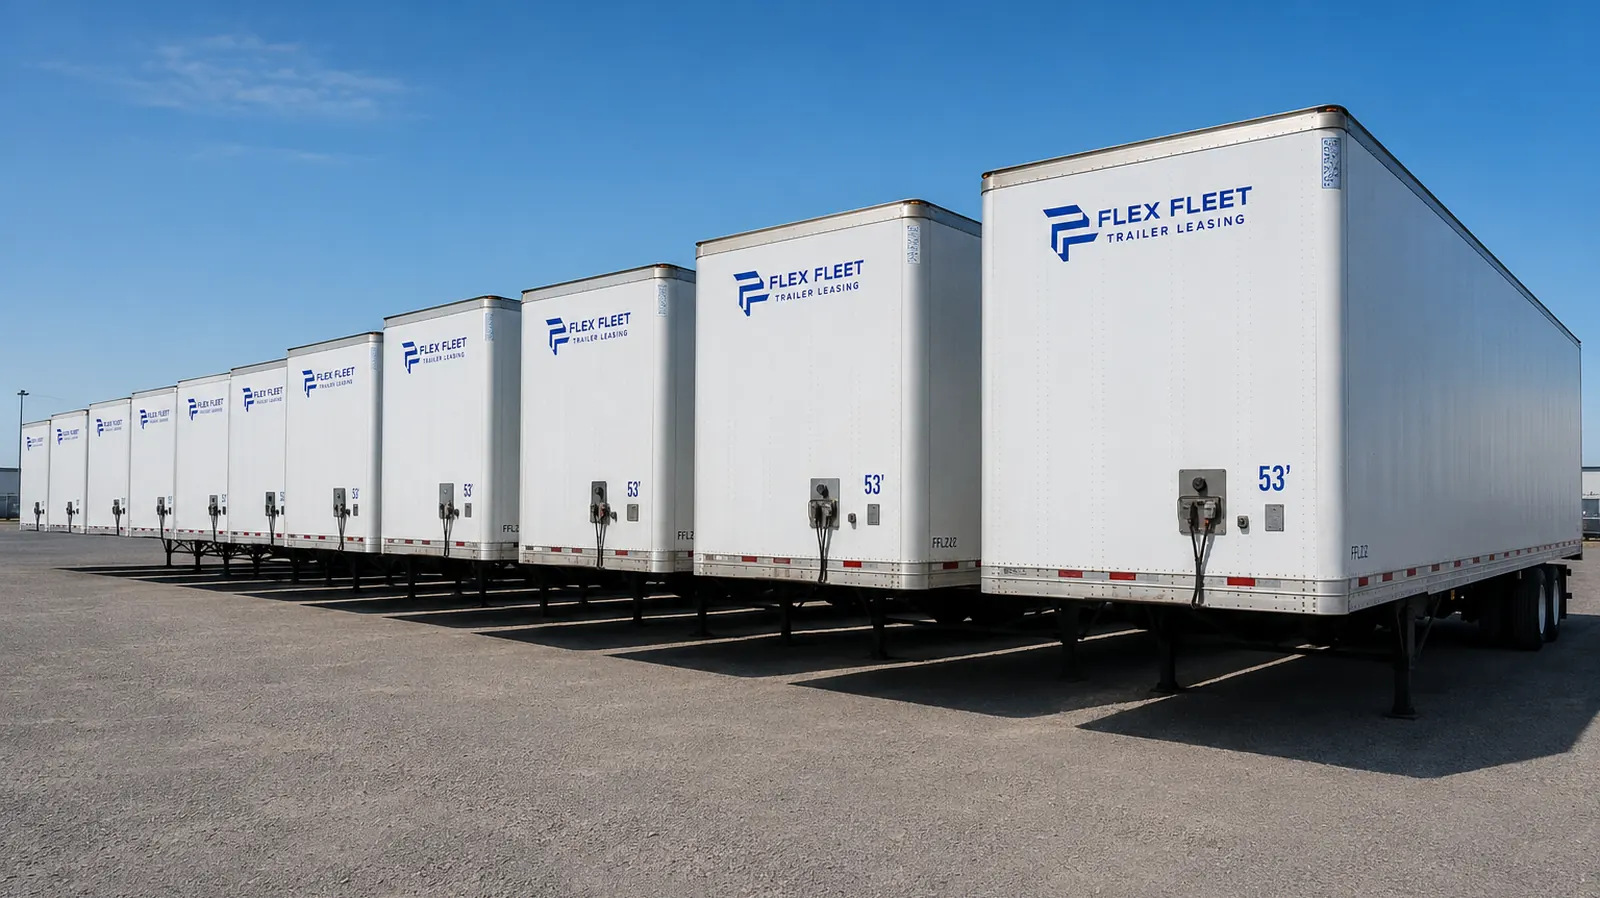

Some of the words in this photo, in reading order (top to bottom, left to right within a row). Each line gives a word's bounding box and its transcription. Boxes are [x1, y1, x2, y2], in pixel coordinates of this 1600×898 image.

[1098, 201, 1160, 228] FLEX
[1170, 185, 1252, 217] FLEET
[1107, 226, 1168, 243] TRAILER
[1177, 214, 1245, 234] LEASING
[769, 270, 809, 290] FLEX
[814, 259, 864, 282] FLEET
[775, 289, 813, 302] TRAILER
[818, 281, 859, 296] LEASING
[569, 319, 595, 333] FLEX
[598, 312, 631, 329] FLEET
[420, 343, 440, 355] FLEX
[442, 337, 467, 351] FLEET
[573, 334, 598, 344] TRAILER
[600, 329, 628, 340] LEASING
[316, 371, 333, 381] FLEX
[334, 366, 355, 379] FLEET
[627, 481, 641, 497] 53'
[864, 474, 884, 495] 53'
